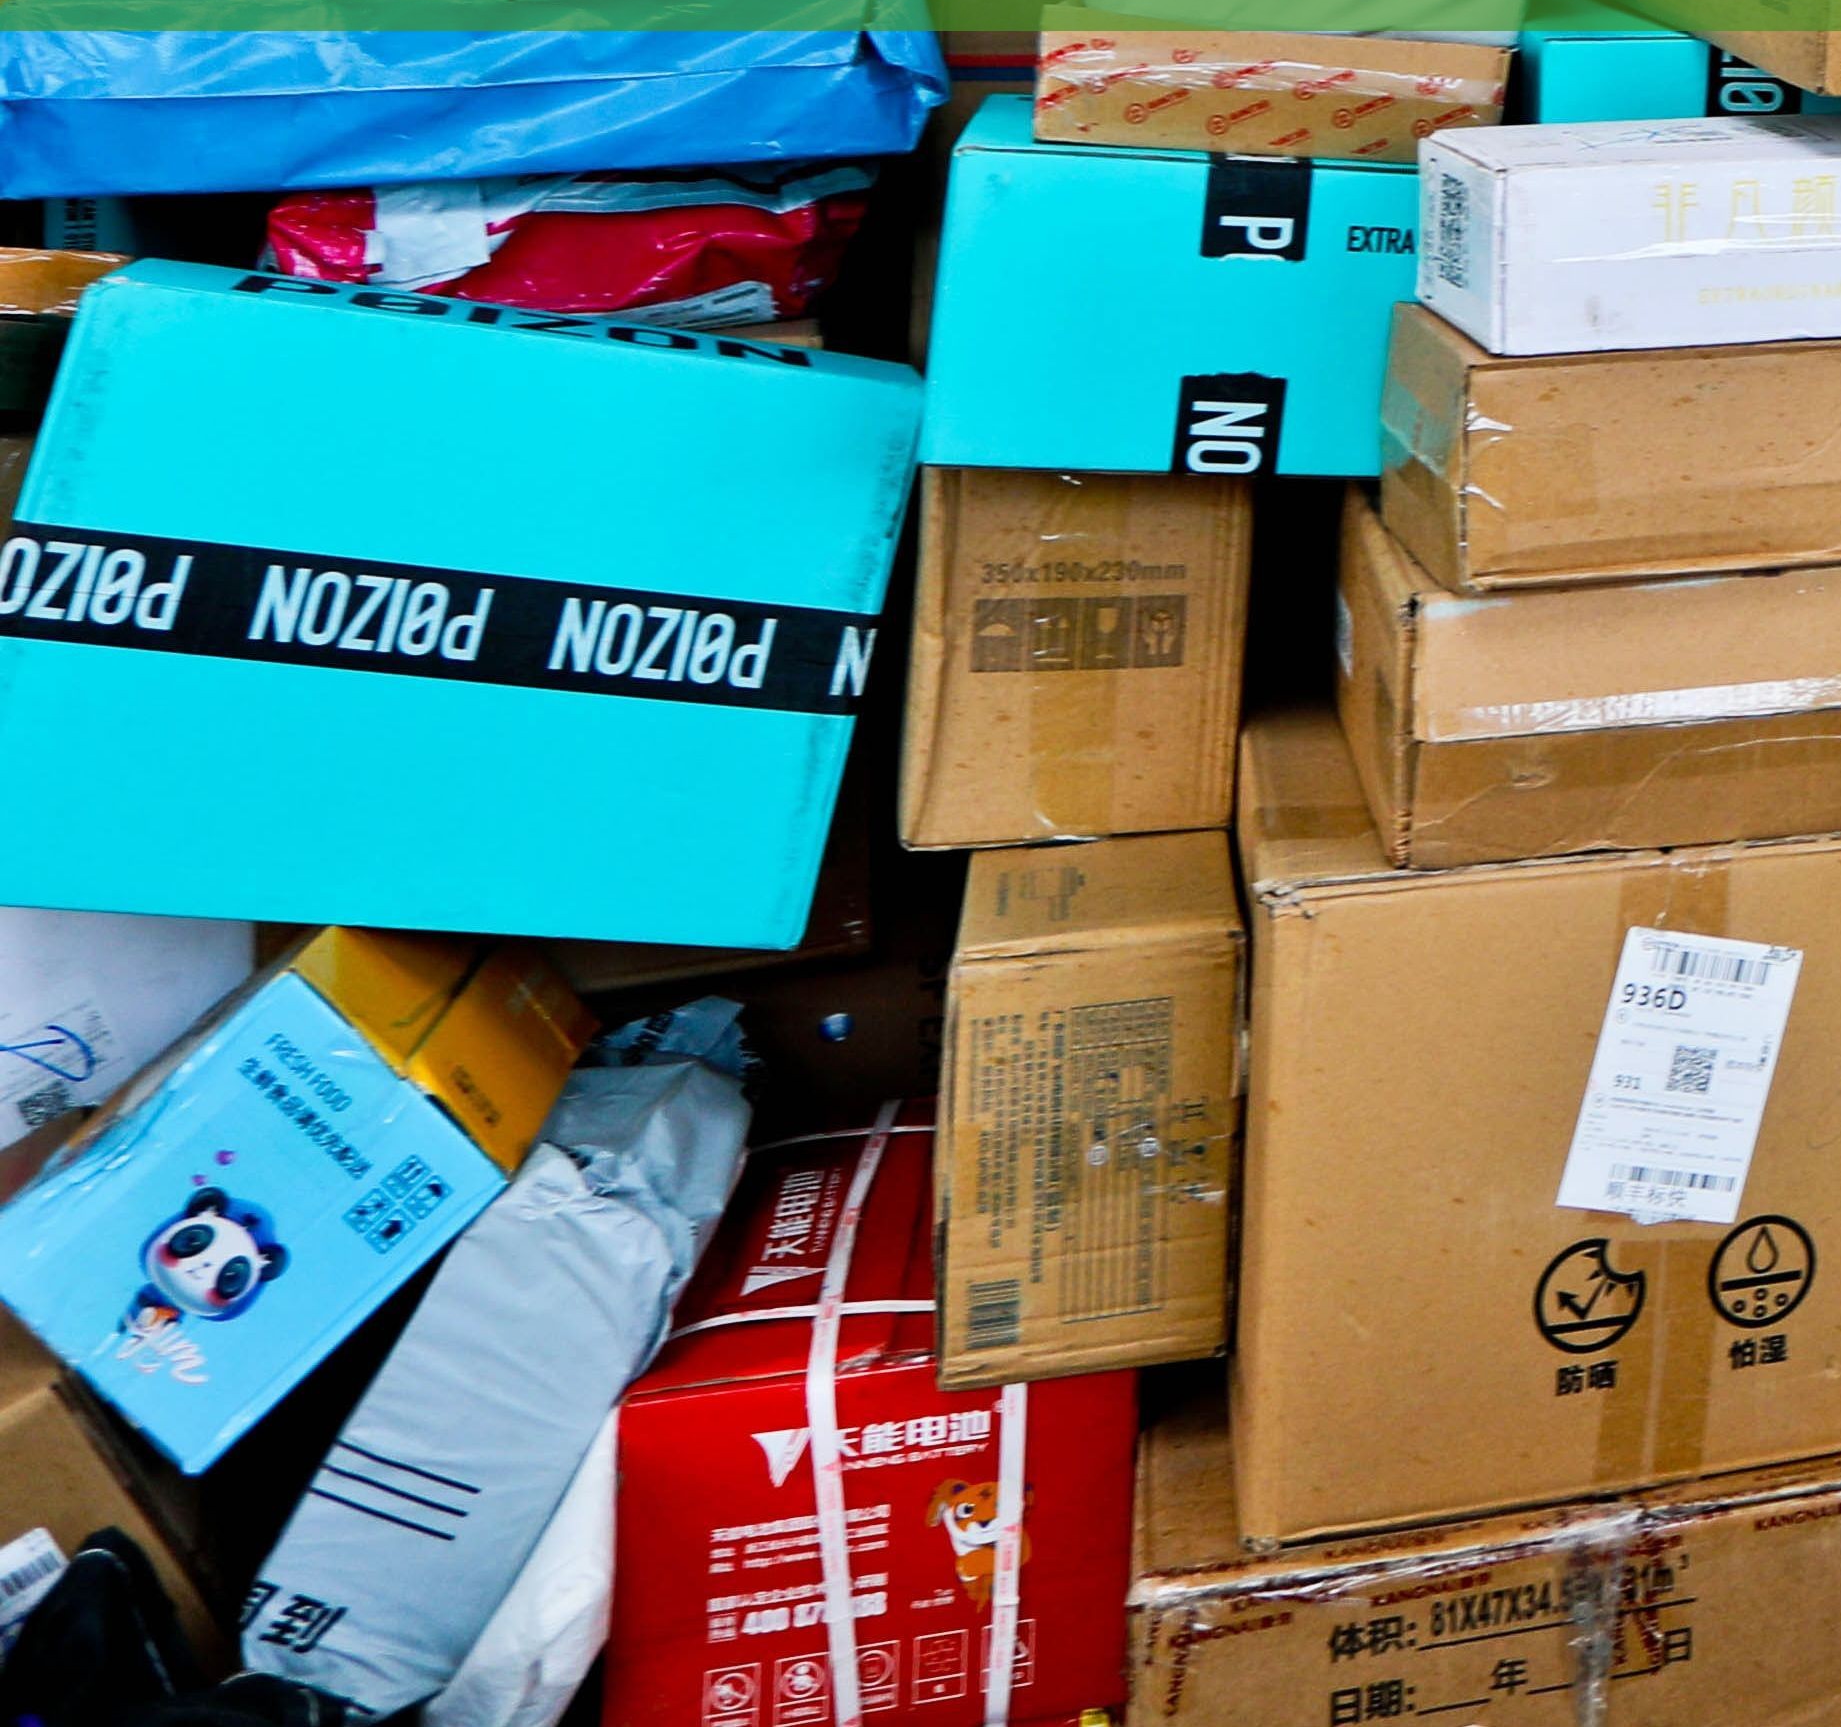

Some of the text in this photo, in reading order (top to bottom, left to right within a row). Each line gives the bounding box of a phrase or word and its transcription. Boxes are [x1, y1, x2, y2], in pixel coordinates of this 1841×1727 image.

[1346, 225, 1415, 255] EXTRA
[1621, 982, 1687, 1011] 936D
[1728, 1333, 1789, 1371] 怕湿
[1554, 1360, 1620, 1398] 防晒
[1328, 1614, 1420, 1664] 体积:
[1329, 1684, 1417, 1725] 日期:
[1490, 1657, 1528, 1697] 年
